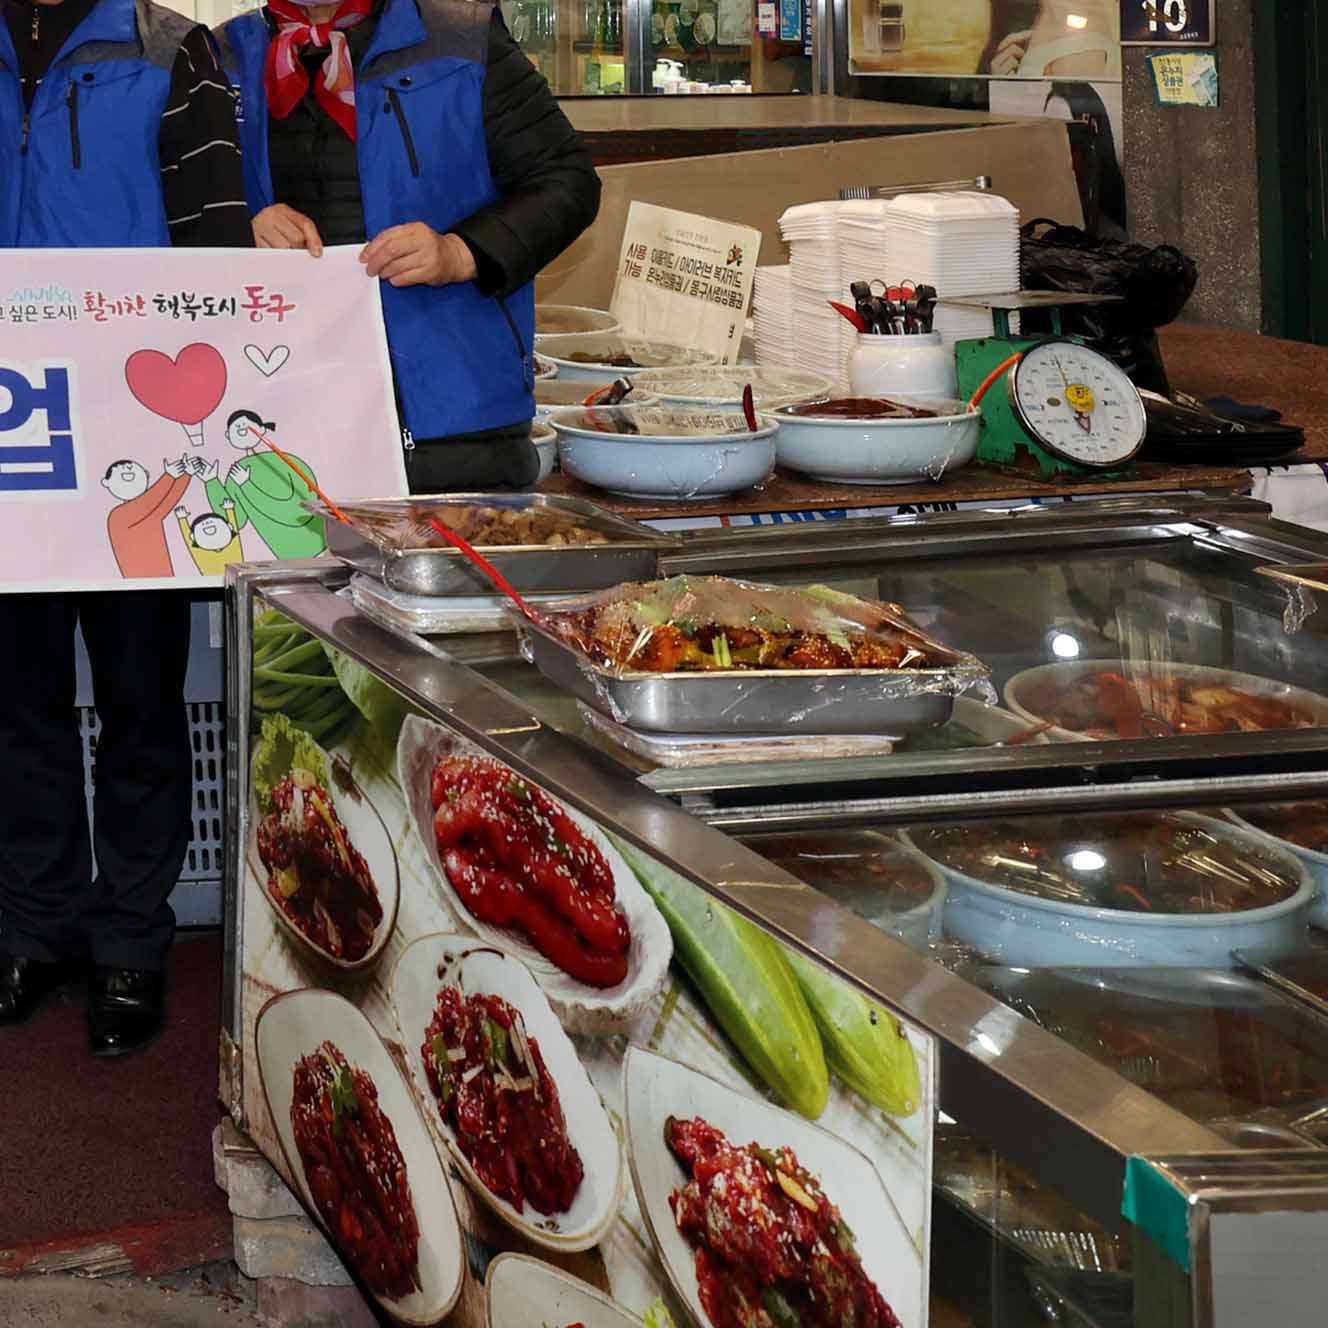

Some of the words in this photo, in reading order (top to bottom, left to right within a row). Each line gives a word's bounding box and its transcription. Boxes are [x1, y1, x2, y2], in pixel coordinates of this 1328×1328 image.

[9, 305, 38, 322] 싶은
[83, 291, 147, 322] 활기찬
[153, 292, 236, 322] 행복도시
[241, 285, 296, 322] 동구
